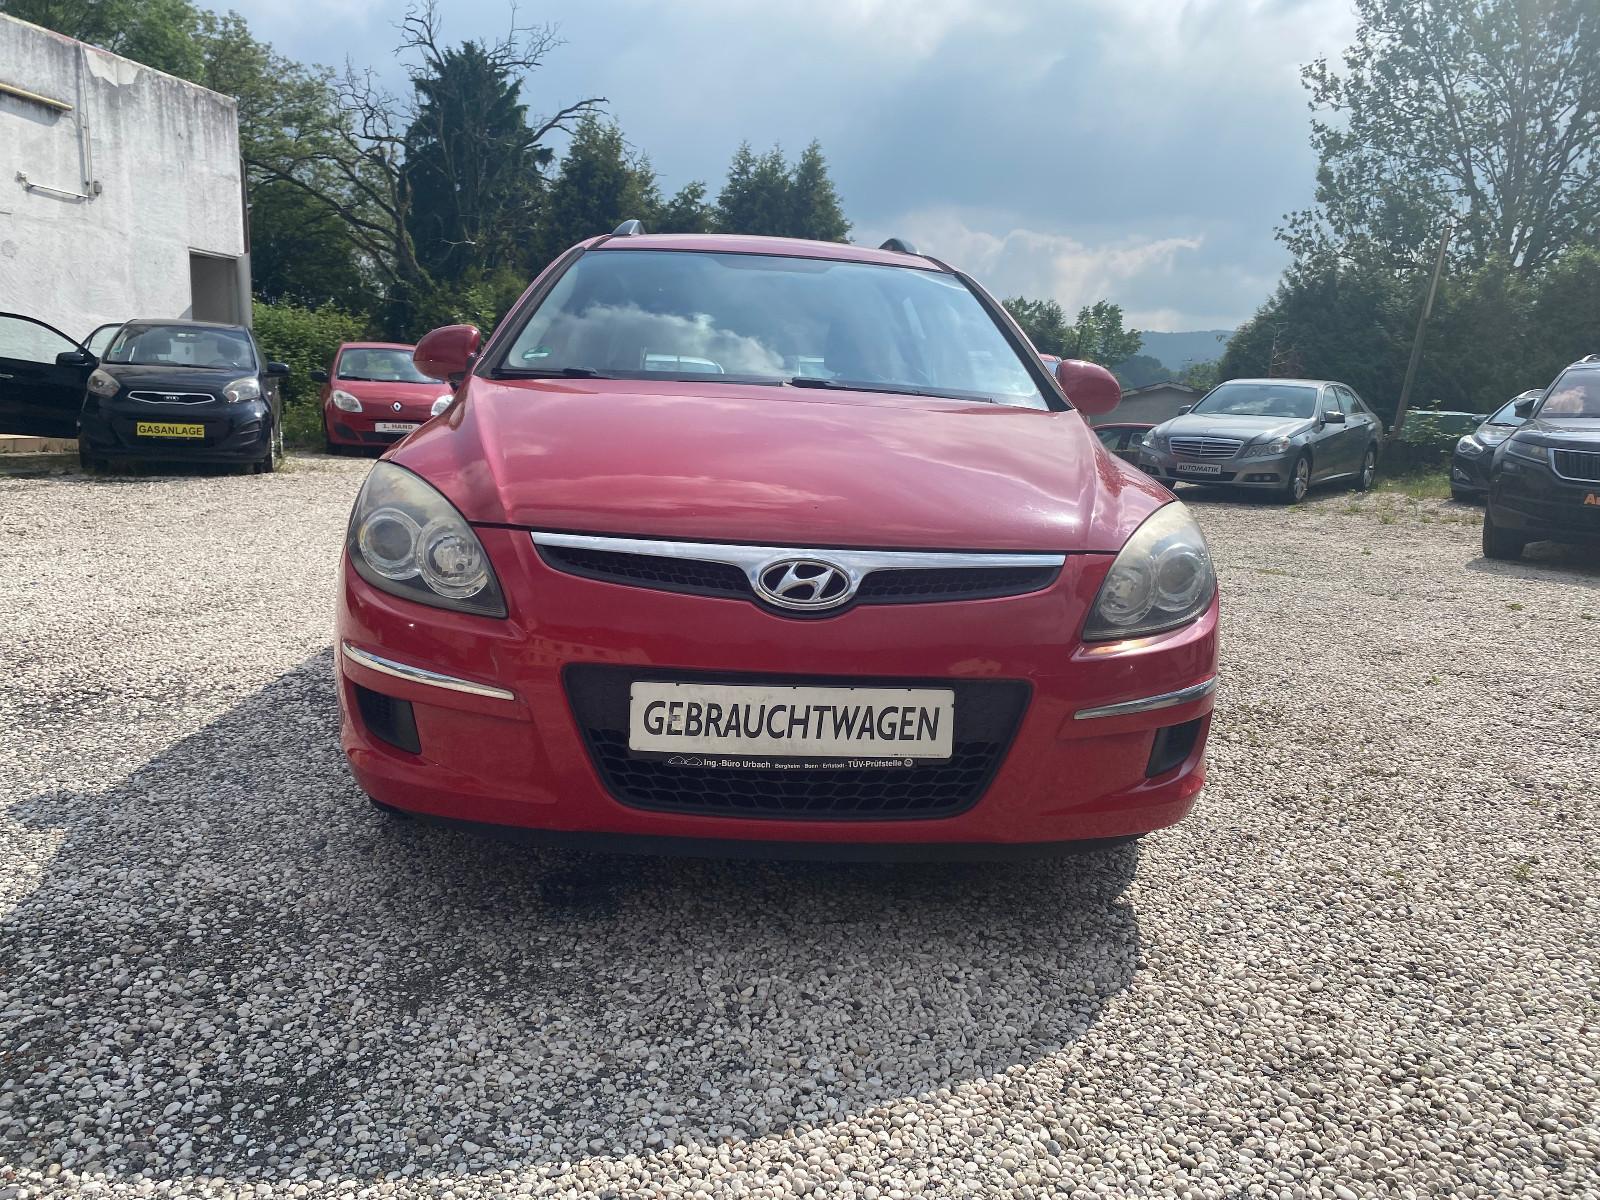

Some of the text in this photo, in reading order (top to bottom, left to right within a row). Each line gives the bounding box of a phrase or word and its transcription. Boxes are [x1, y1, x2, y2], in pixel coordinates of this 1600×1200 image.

[138, 425, 203, 436] GASANLAGE
[1178, 464, 1219, 473] AUTOMATIK
[643, 700, 940, 741] GEBRAUCHTWAGEN
[703, 758, 741, 768] Ing.-Büro
[742, 760, 771, 769] Urbach
[848, 758, 902, 768] TÜV-Prüfstelle
